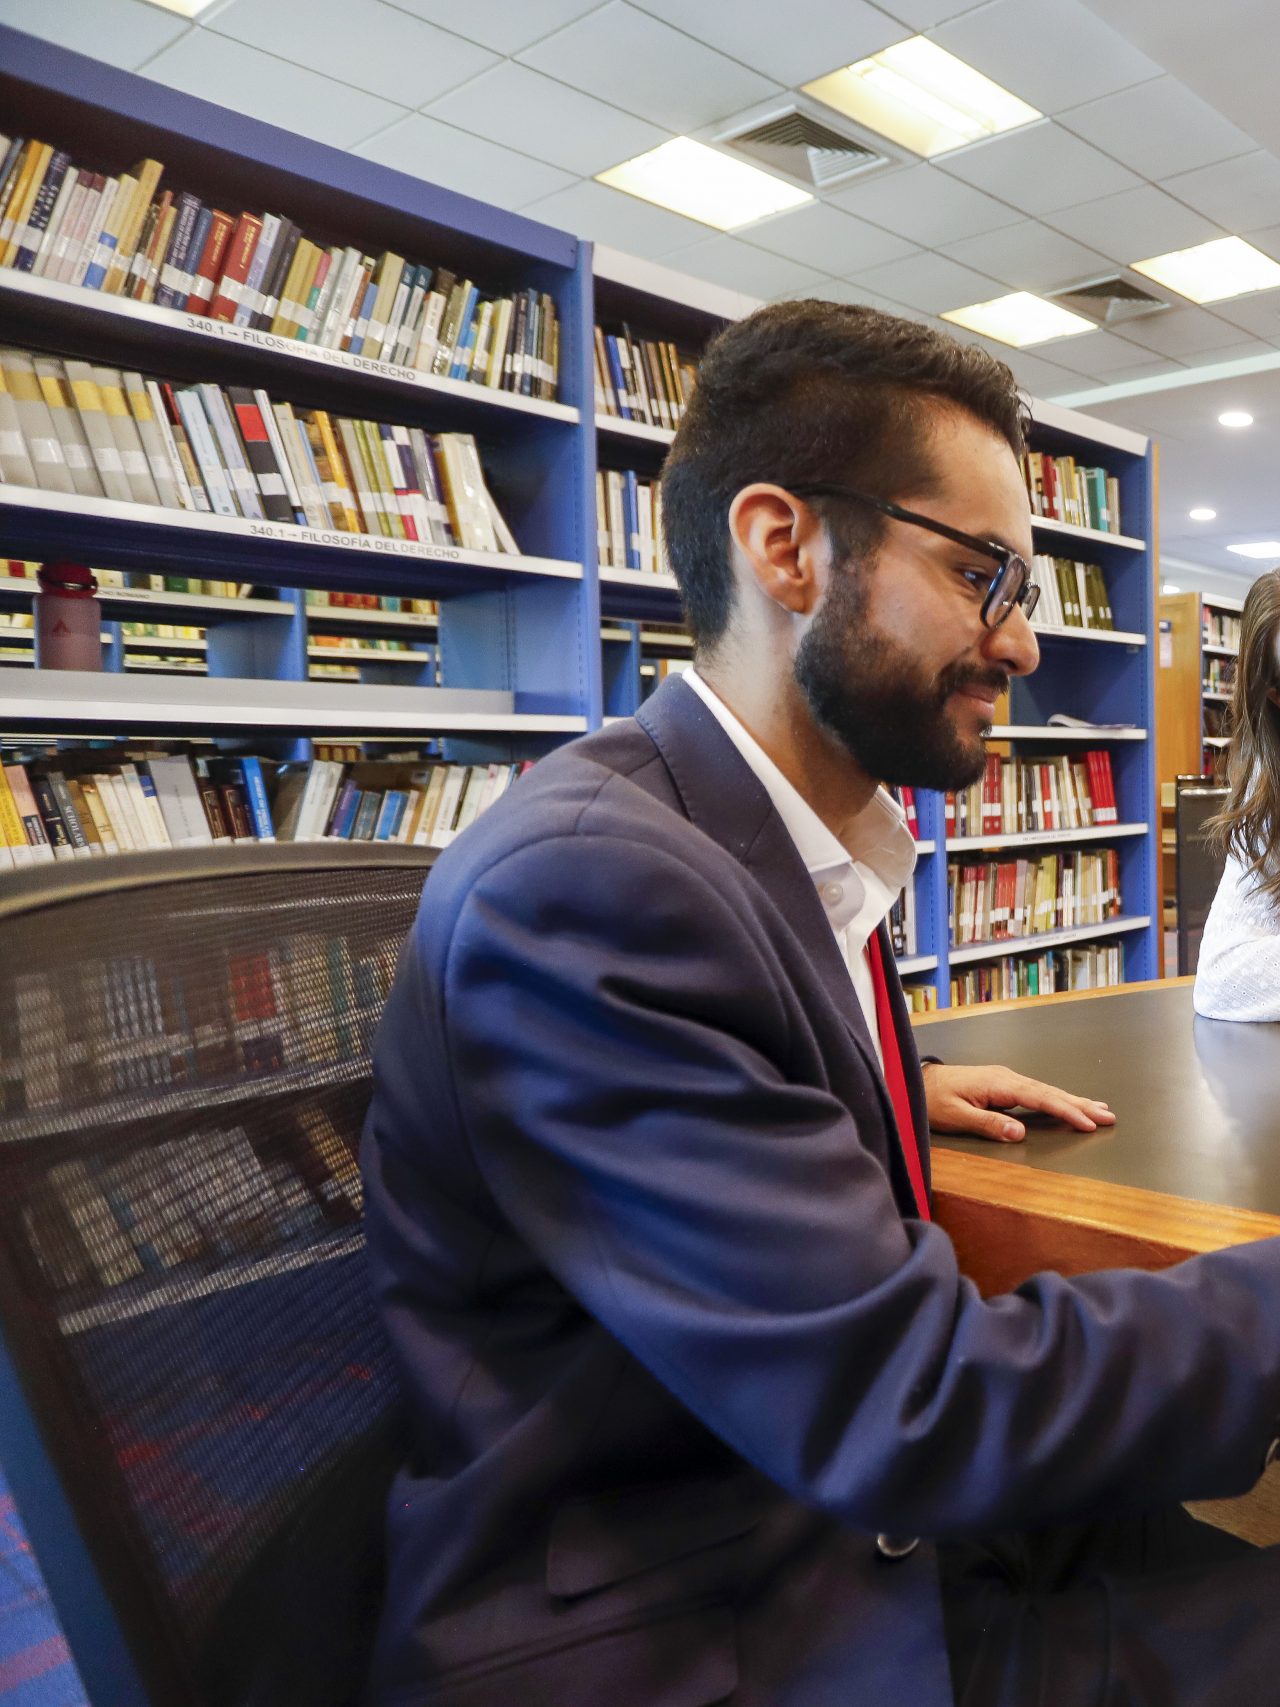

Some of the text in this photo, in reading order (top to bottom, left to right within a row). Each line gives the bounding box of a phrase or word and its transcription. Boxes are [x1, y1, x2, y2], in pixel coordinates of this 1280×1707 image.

[187, 317, 225, 335] 340.1
[353, 357, 416, 381] DERECHO
[249, 524, 284, 538] 340.1
[374, 540, 399, 552] DEL
[400, 543, 460, 560] DERECHO
